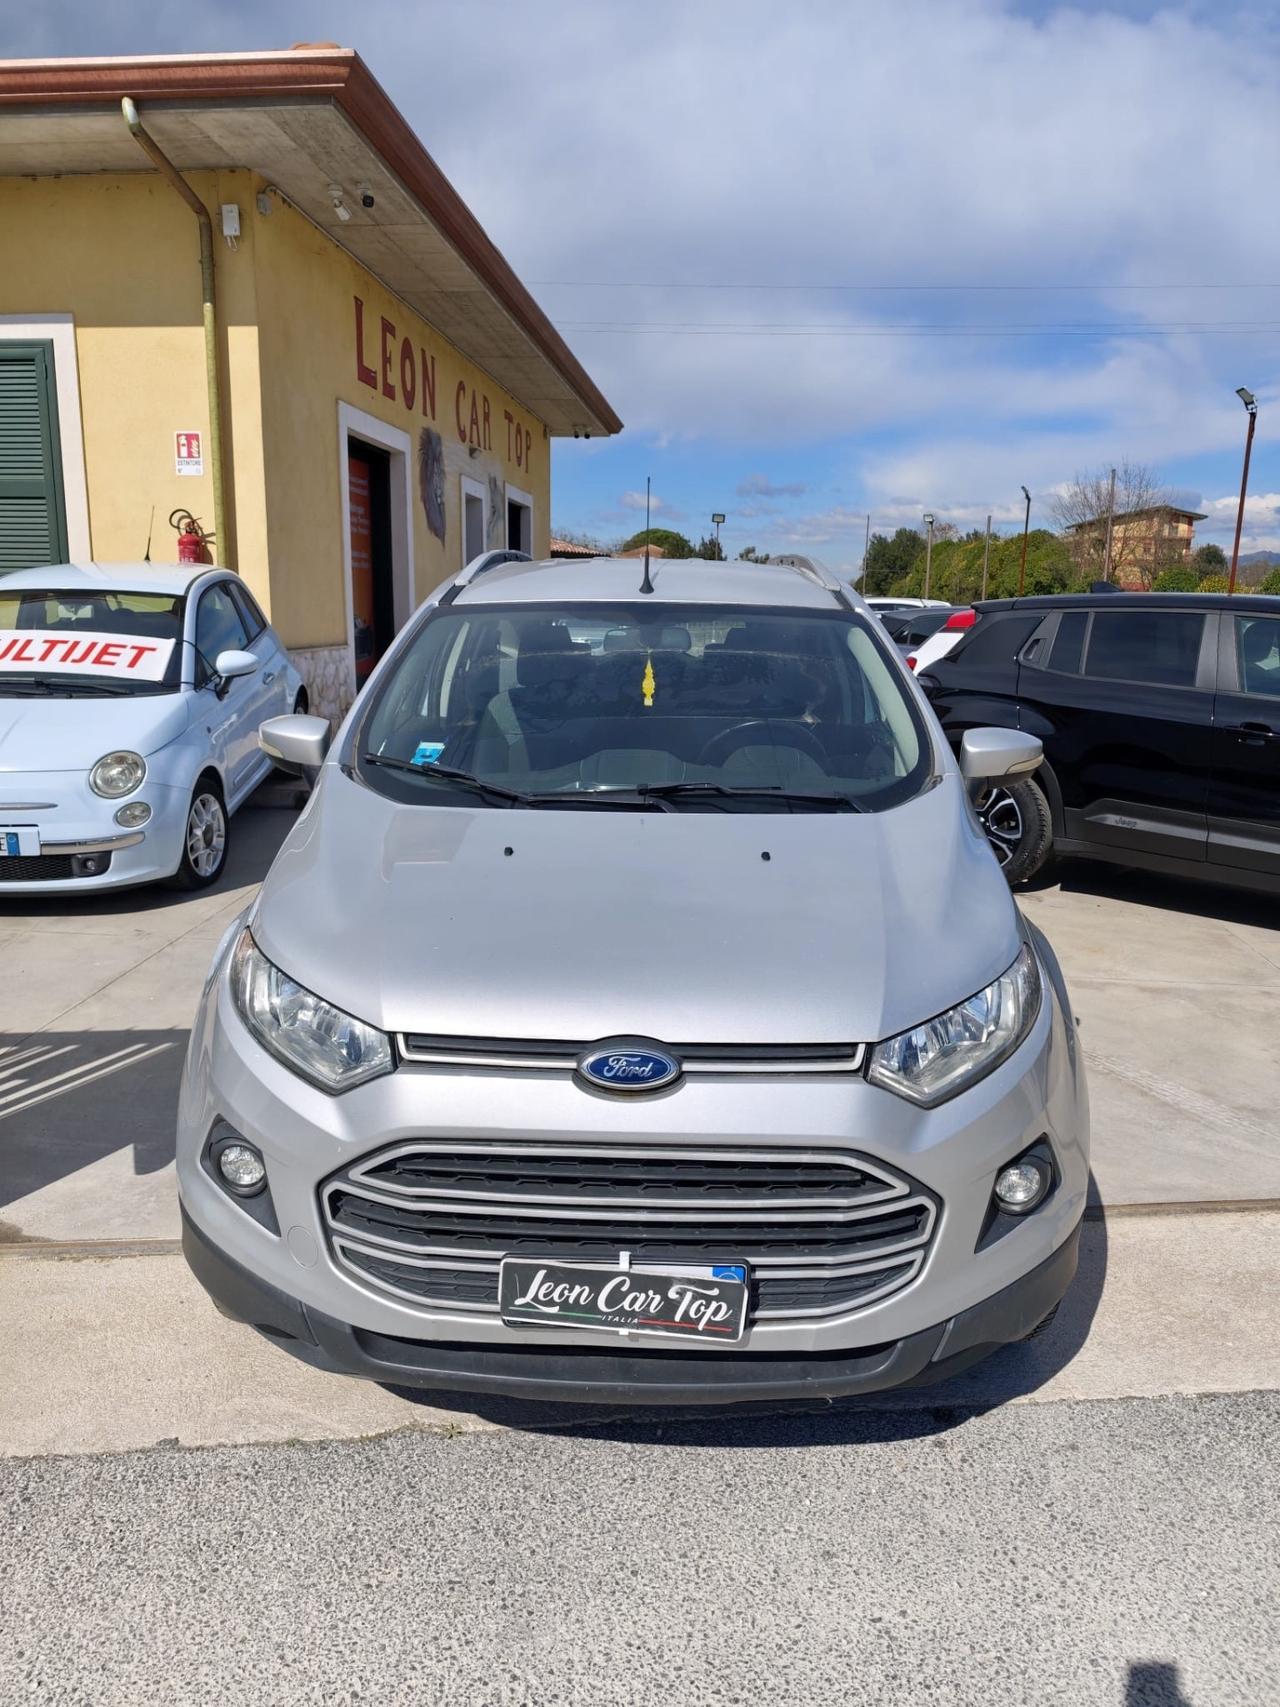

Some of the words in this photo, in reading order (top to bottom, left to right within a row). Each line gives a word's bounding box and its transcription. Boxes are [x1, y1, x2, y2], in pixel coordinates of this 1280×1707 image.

[354, 296, 436, 421] LEON
[456, 380, 492, 451] CAR
[504, 409, 532, 474] TOP
[514, 1269, 594, 1313] Leon
[597, 1276, 664, 1313] Car
[667, 1285, 733, 1331] Top
[601, 1315, 639, 1324] ITALIA
